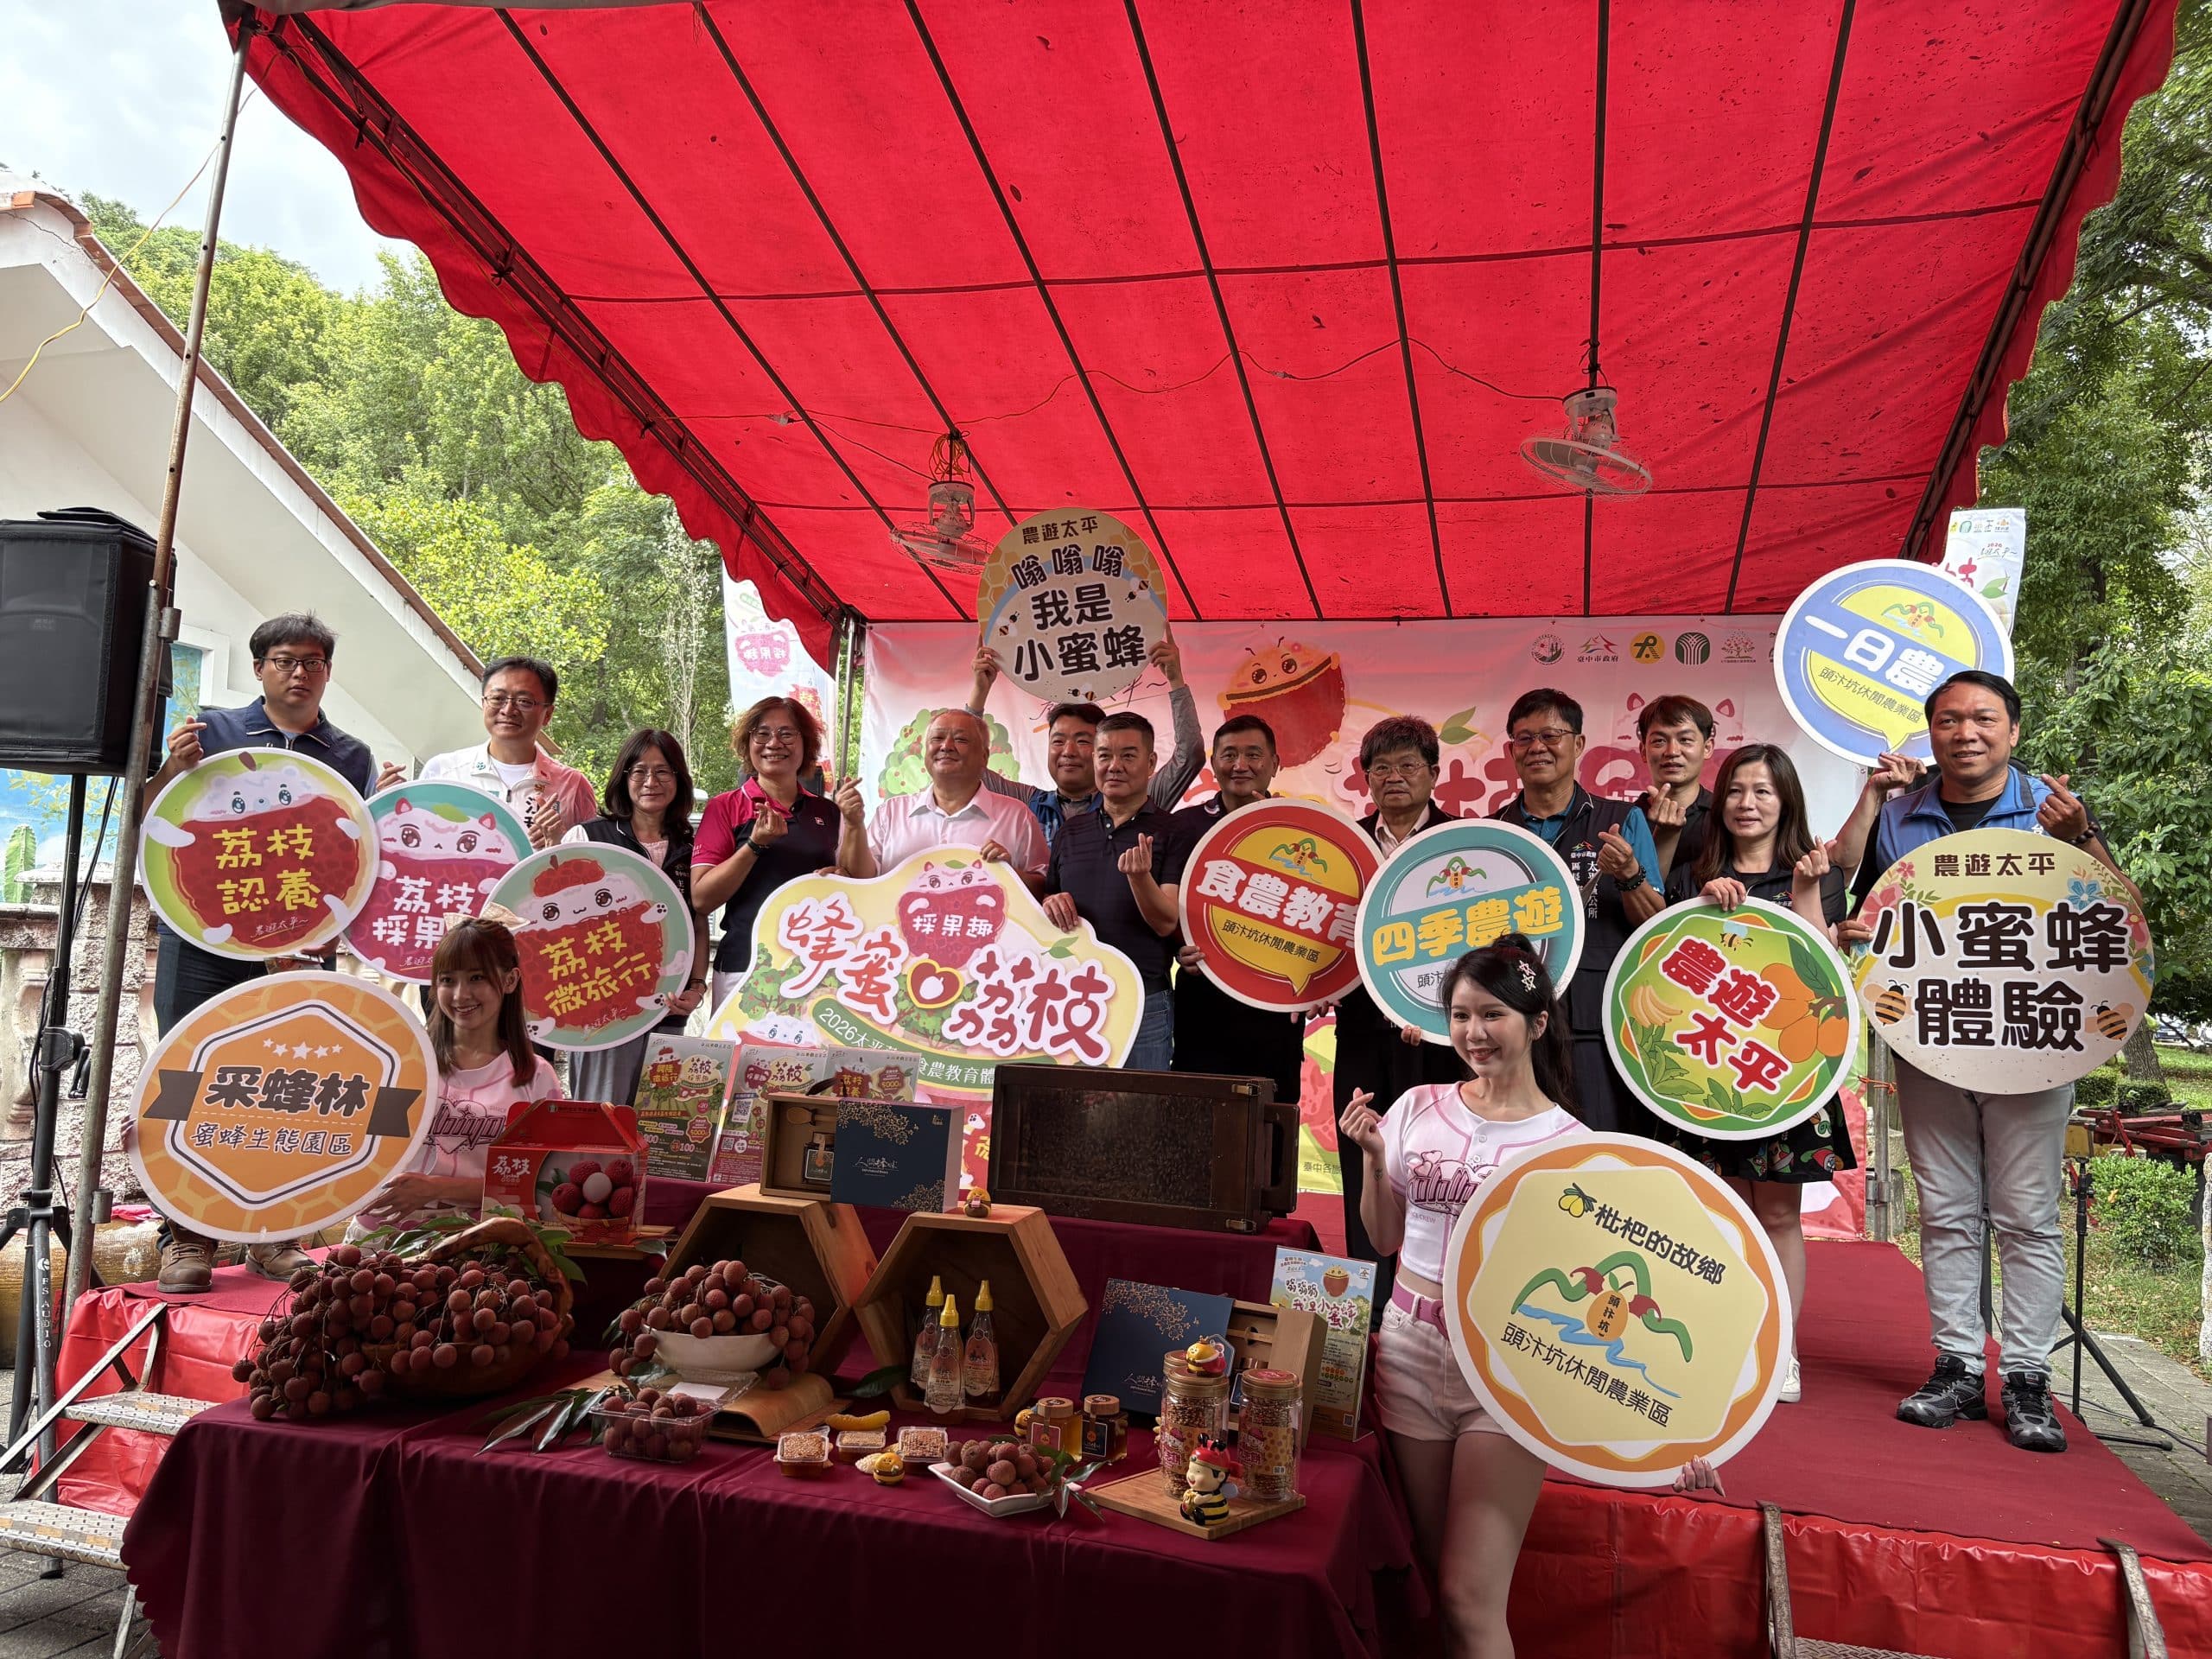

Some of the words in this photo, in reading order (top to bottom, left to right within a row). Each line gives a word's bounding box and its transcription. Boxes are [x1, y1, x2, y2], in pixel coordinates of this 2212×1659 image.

[1021, 516, 1098, 544] 農遊太平
[1011, 544, 1124, 588] 嗡嗡嗡
[1031, 583, 1112, 630] 我是
[1014, 625, 1146, 681] 小蜜蜂
[1805, 614, 1951, 696] 一日農
[212, 822, 316, 870] 荔枝
[1934, 853, 2056, 878] 農遊太平
[217, 869, 321, 916] 認養
[393, 875, 476, 914] 荔枝
[539, 920, 627, 981] 荔枝
[912, 912, 994, 940] 採果趣
[1222, 918, 1321, 963] 頭汴坑休閒農業區
[1374, 887, 1563, 967] 四季農遊
[1872, 902, 2132, 973] 小蜜蜂
[544, 952, 651, 1016] 微旅行
[785, 899, 900, 1019] 蜂蜜
[949, 951, 1110, 1059] 荔枝
[1662, 939, 1781, 1027] 農遊
[1915, 979, 2084, 1052] 體驗
[772, 1061, 804, 1083] 荔枝
[1677, 1014, 1788, 1090] 太平
[205, 1065, 372, 1116] 采蜂林
[191, 1124, 353, 1156] 蜜蜂生態園區
[492, 1155, 531, 1175] 荔枝
[1594, 1203, 1726, 1286] 枇杷的故鄉
[1500, 1321, 1673, 1427] 頭汴坑休閒農業區
